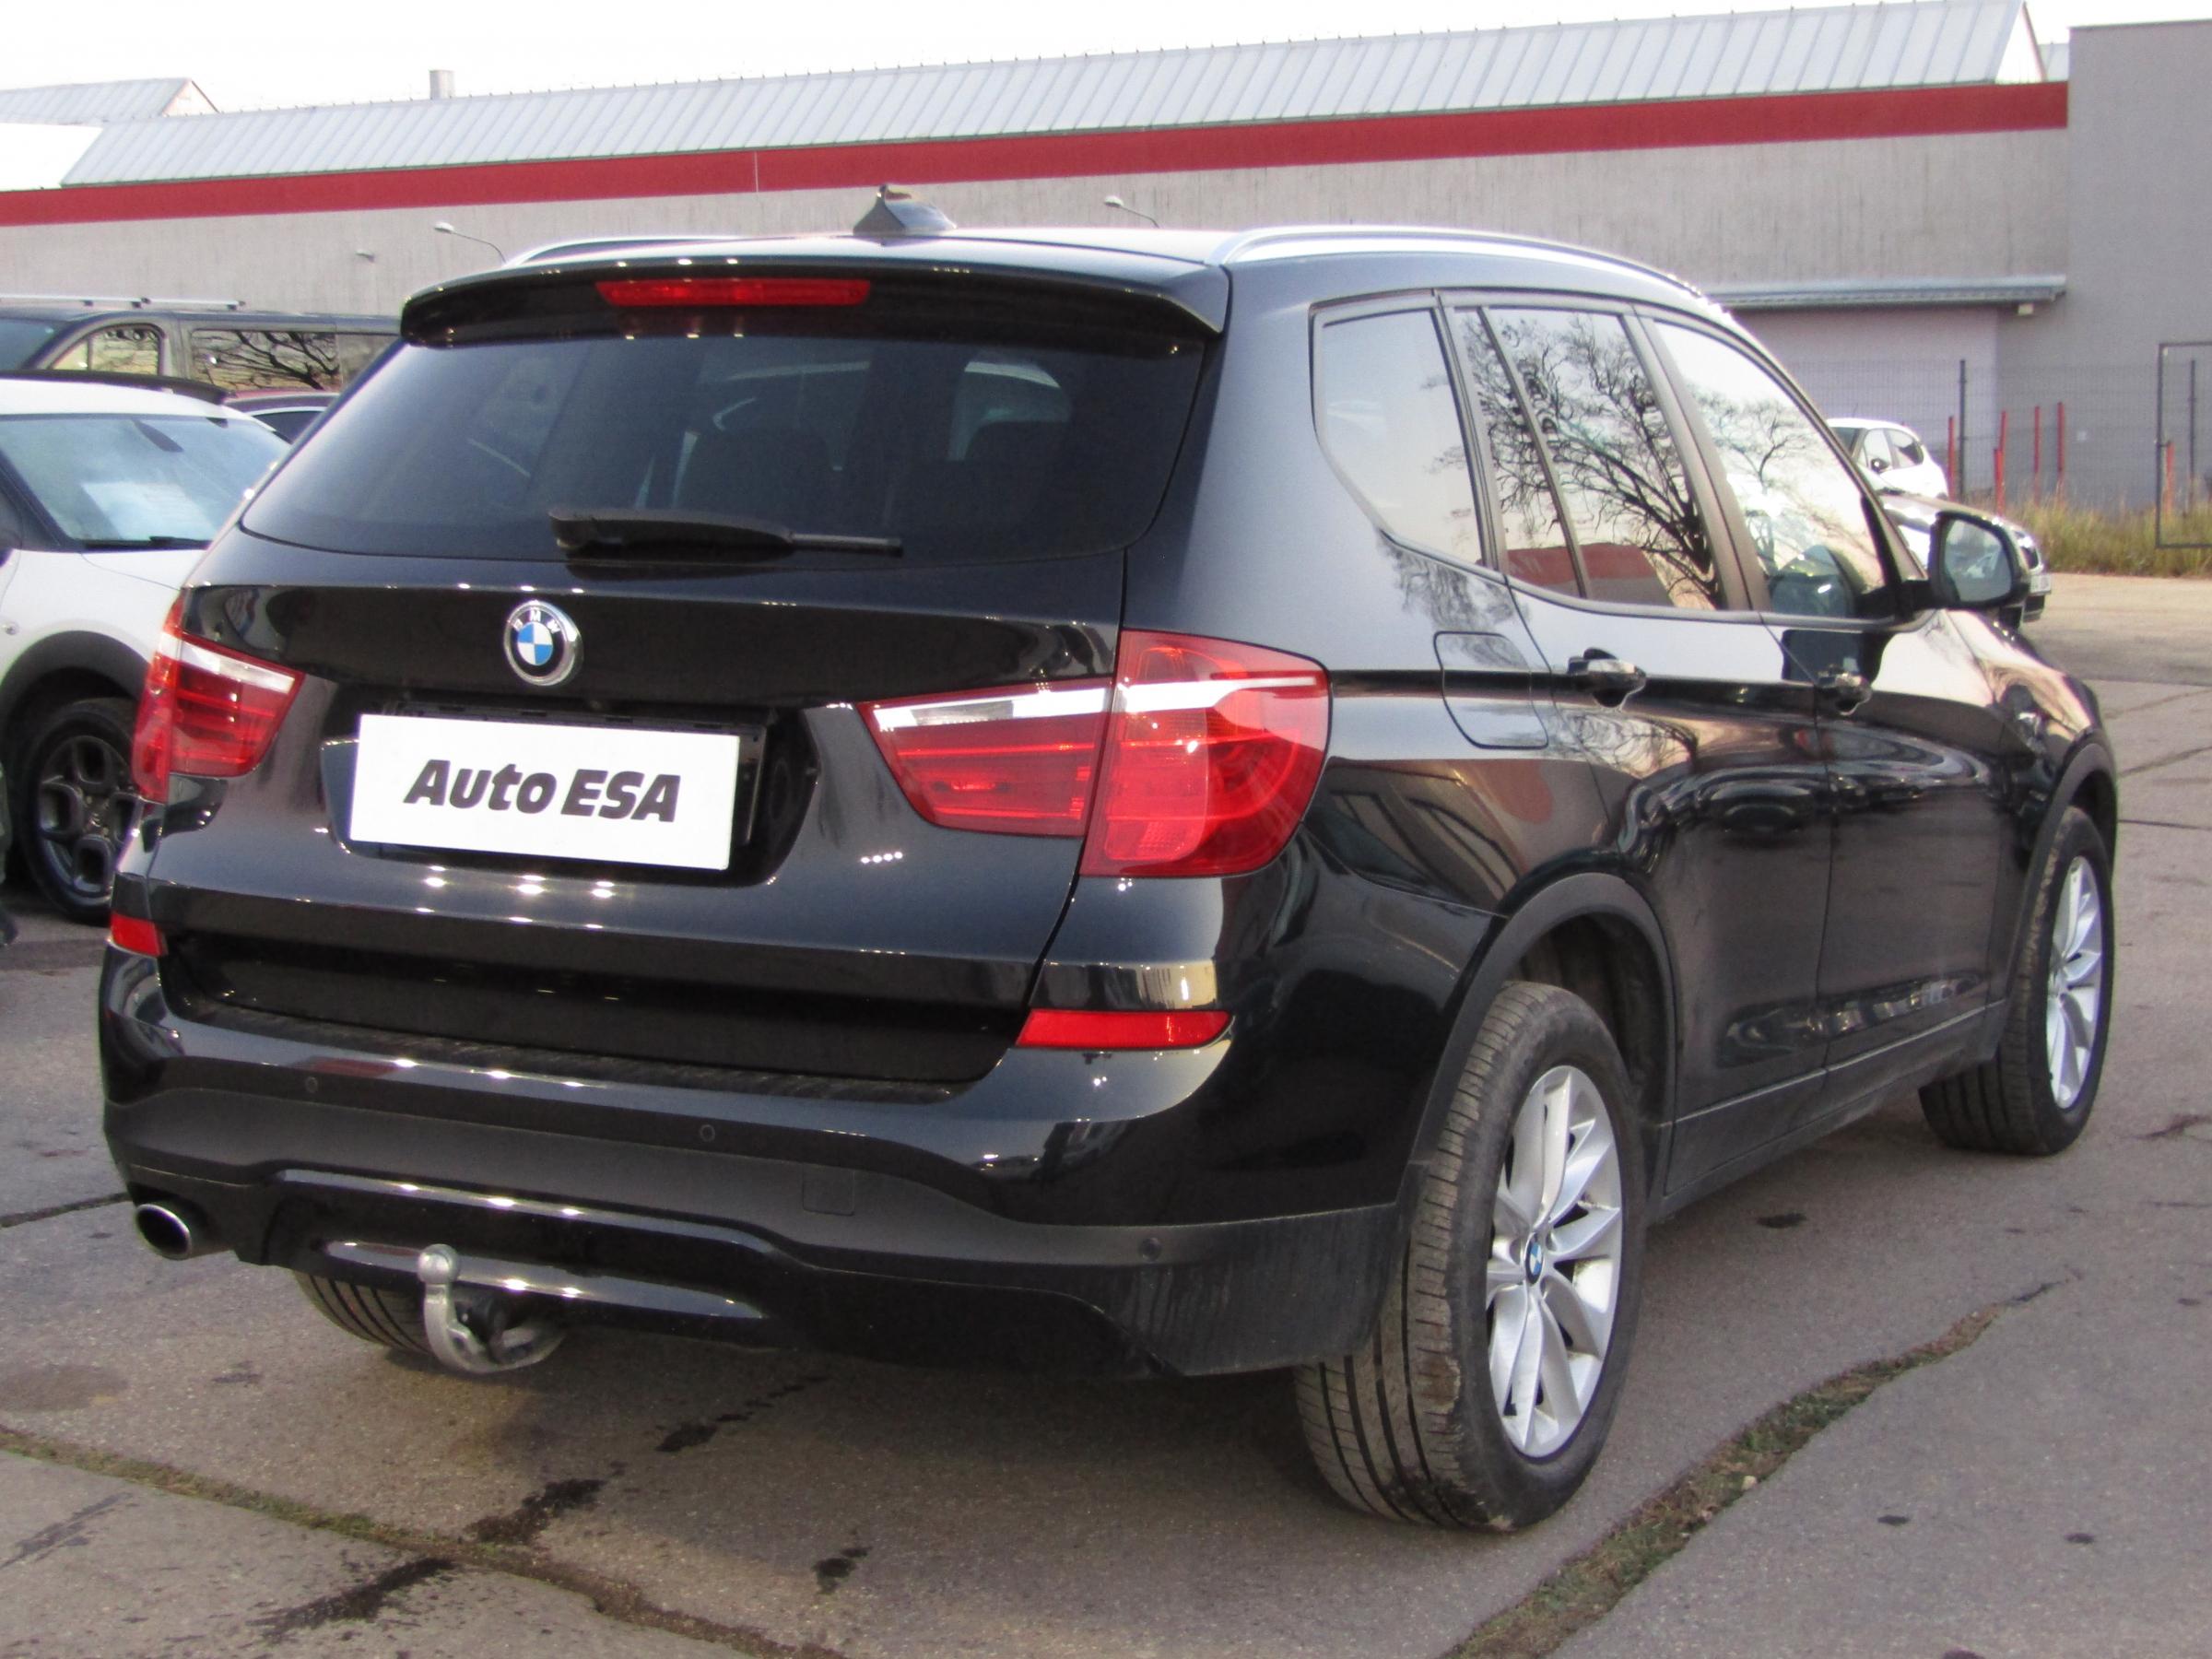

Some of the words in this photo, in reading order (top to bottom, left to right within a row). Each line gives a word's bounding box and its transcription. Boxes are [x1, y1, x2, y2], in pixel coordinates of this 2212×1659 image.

[512, 607, 560, 633] BMW
[404, 759, 556, 814] Auto
[561, 769, 680, 822] ESA
